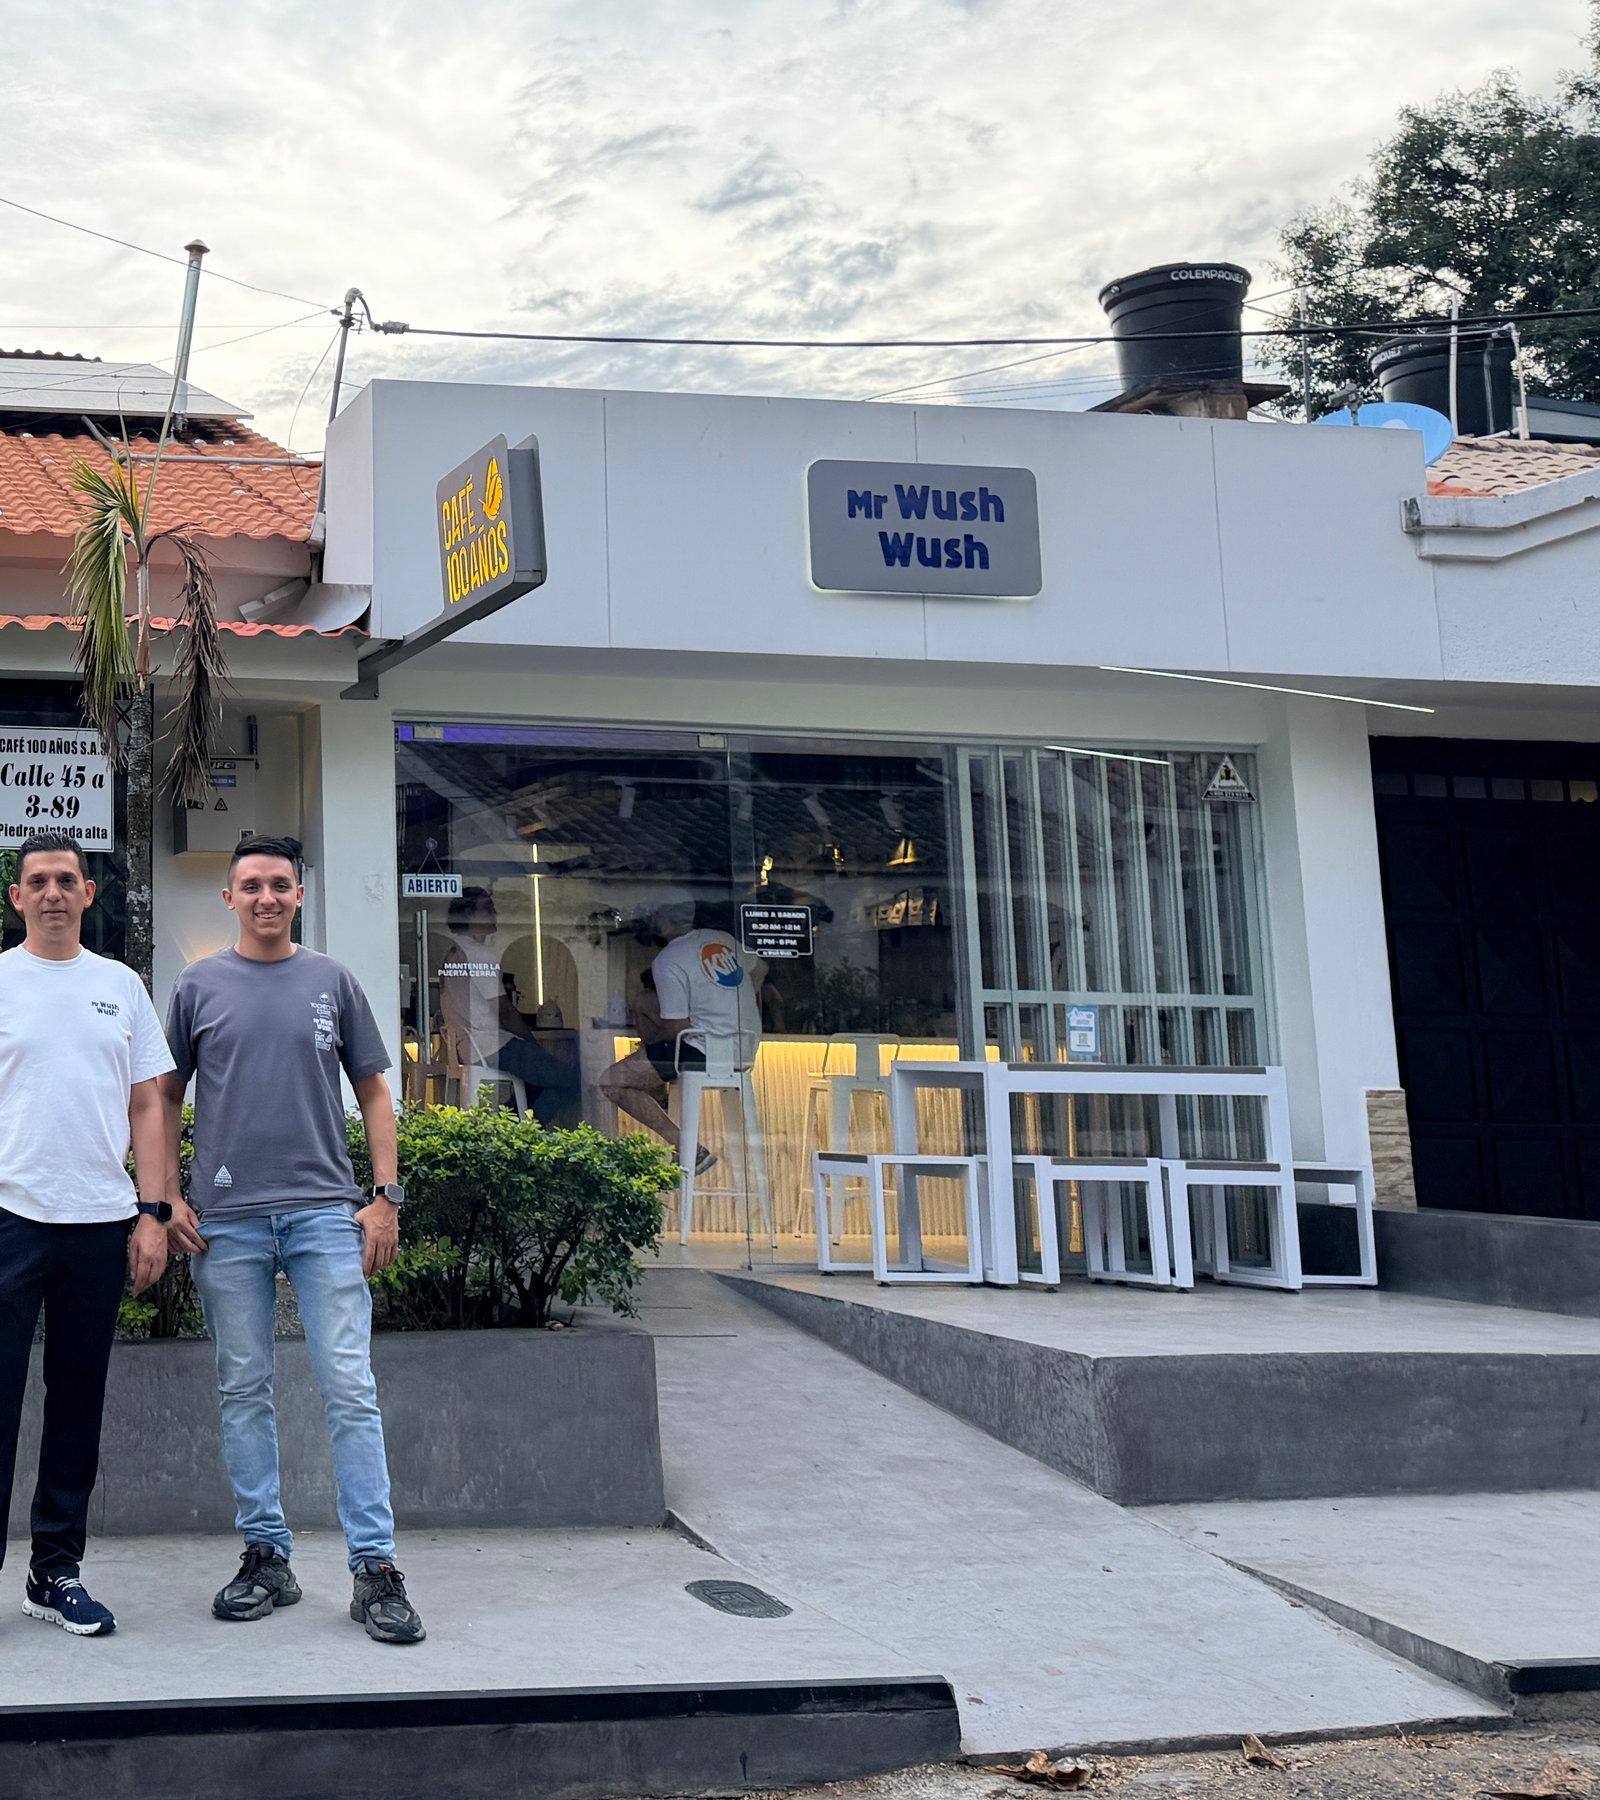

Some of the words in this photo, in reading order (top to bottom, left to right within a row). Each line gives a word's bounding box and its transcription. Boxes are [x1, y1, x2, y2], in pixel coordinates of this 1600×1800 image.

[443, 474, 476, 550] CAFÉ
[847, 489, 889, 519] Mr
[894, 484, 1005, 522] Wush
[878, 531, 990, 569] Wush
[0, 737, 25, 753] CAFÉ
[27, 740, 46, 754] 100
[48, 738, 78, 755] AÑOS
[0, 763, 55, 787] Calle
[60, 765, 86, 788] 45
[92, 773, 105, 789] a
[25, 795, 80, 818] 3-89
[85, 826, 108, 839] alta
[407, 879, 458, 894] ABIERTO
[438, 969, 468, 977] PUERTA
[444, 962, 488, 970] MANTENER
